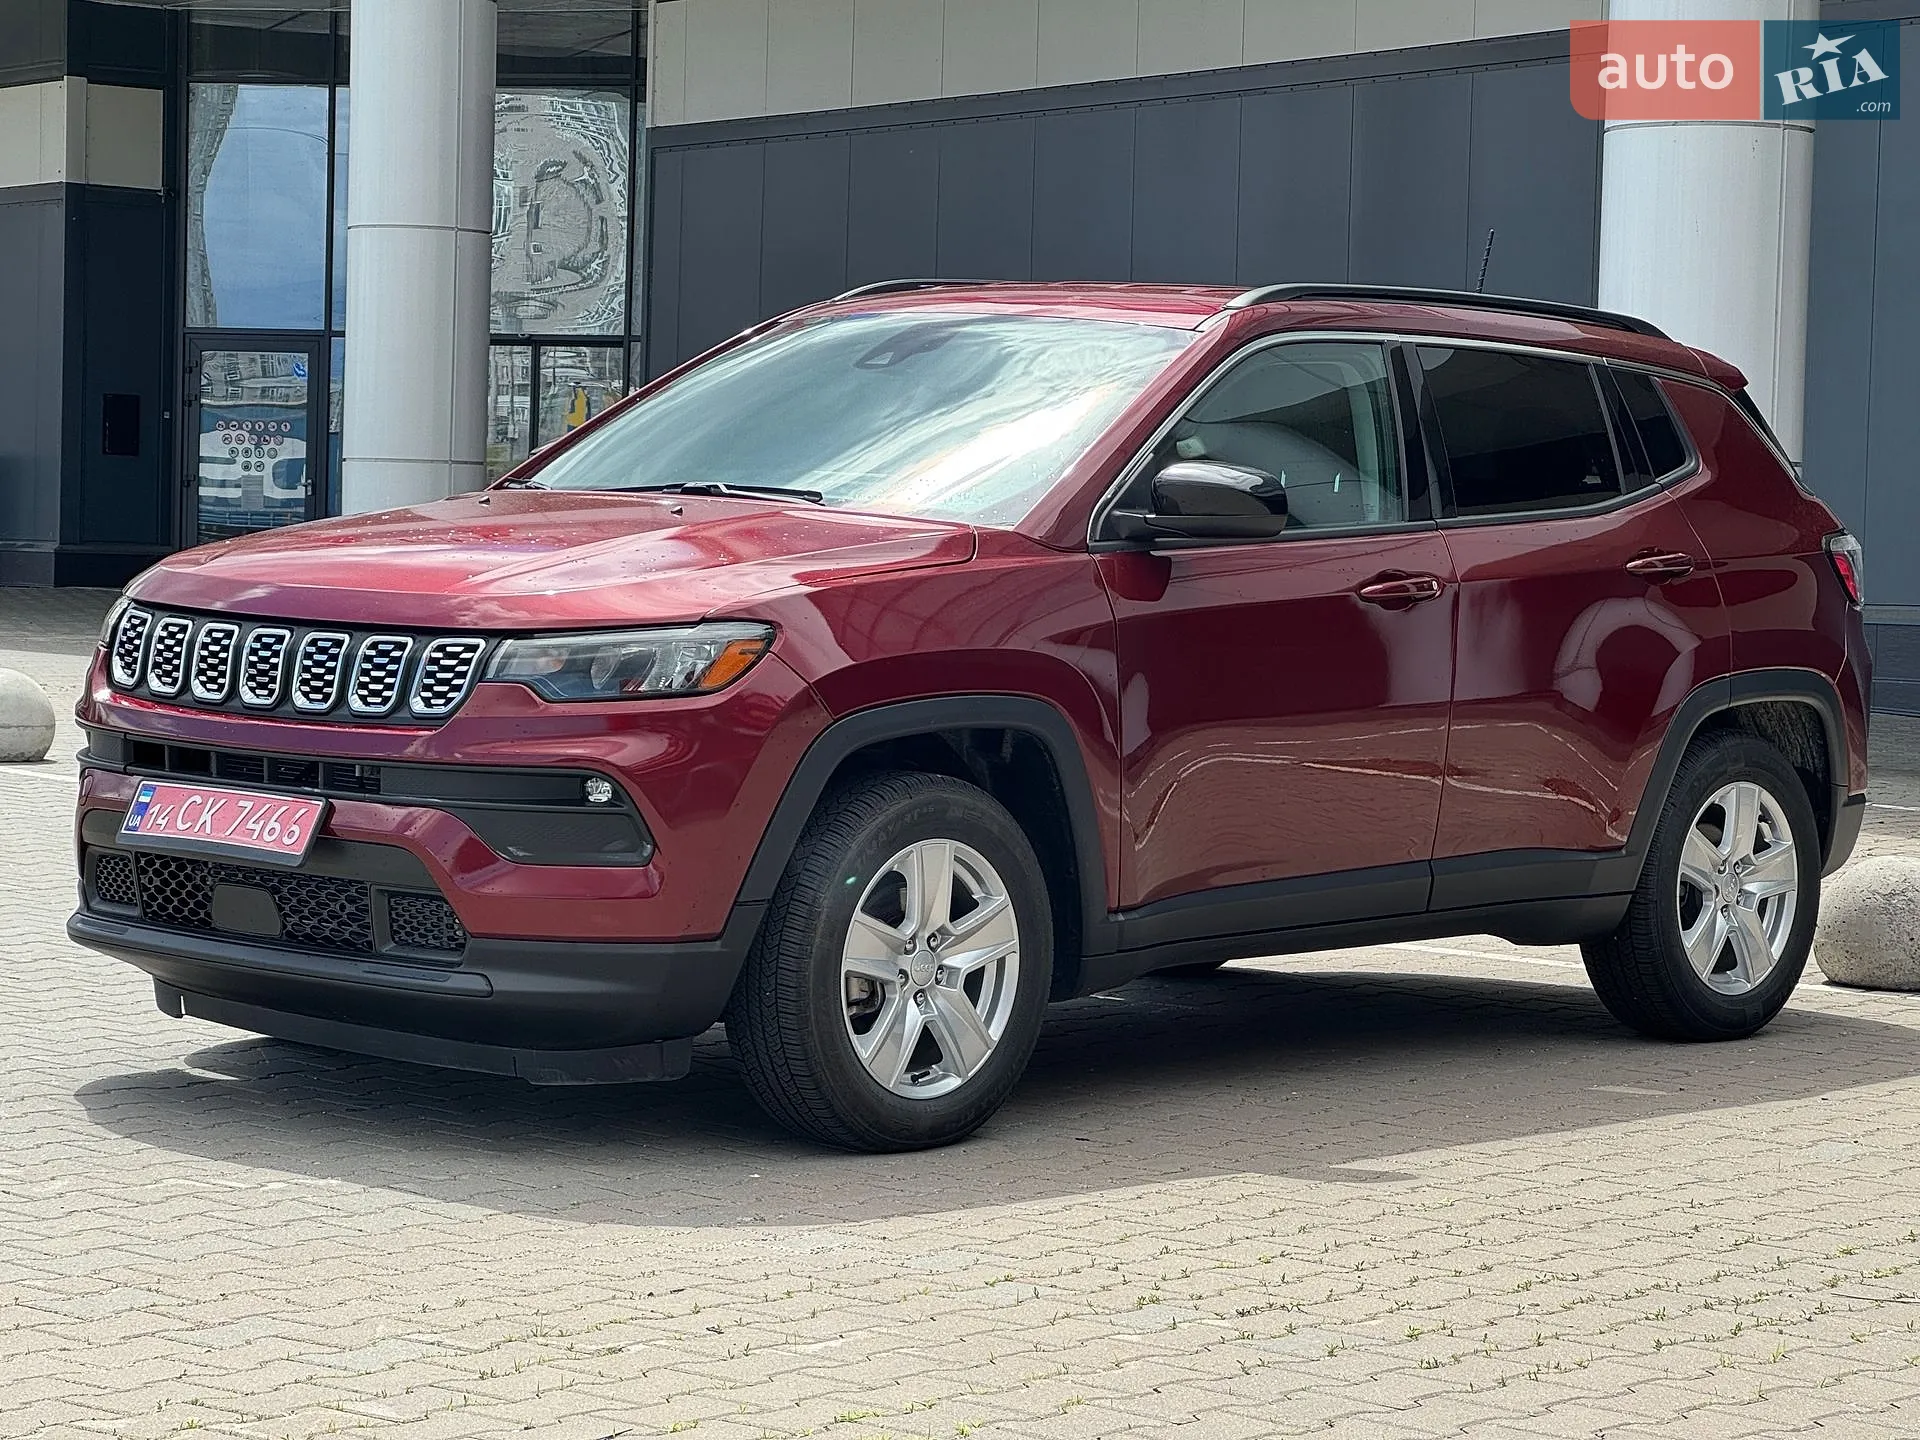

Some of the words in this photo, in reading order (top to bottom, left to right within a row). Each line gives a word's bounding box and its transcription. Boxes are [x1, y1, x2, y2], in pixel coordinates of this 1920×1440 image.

[128, 814, 141, 827] UA
[147, 803, 175, 831] 14
[176, 794, 228, 835] CK
[224, 800, 311, 846] 7466
